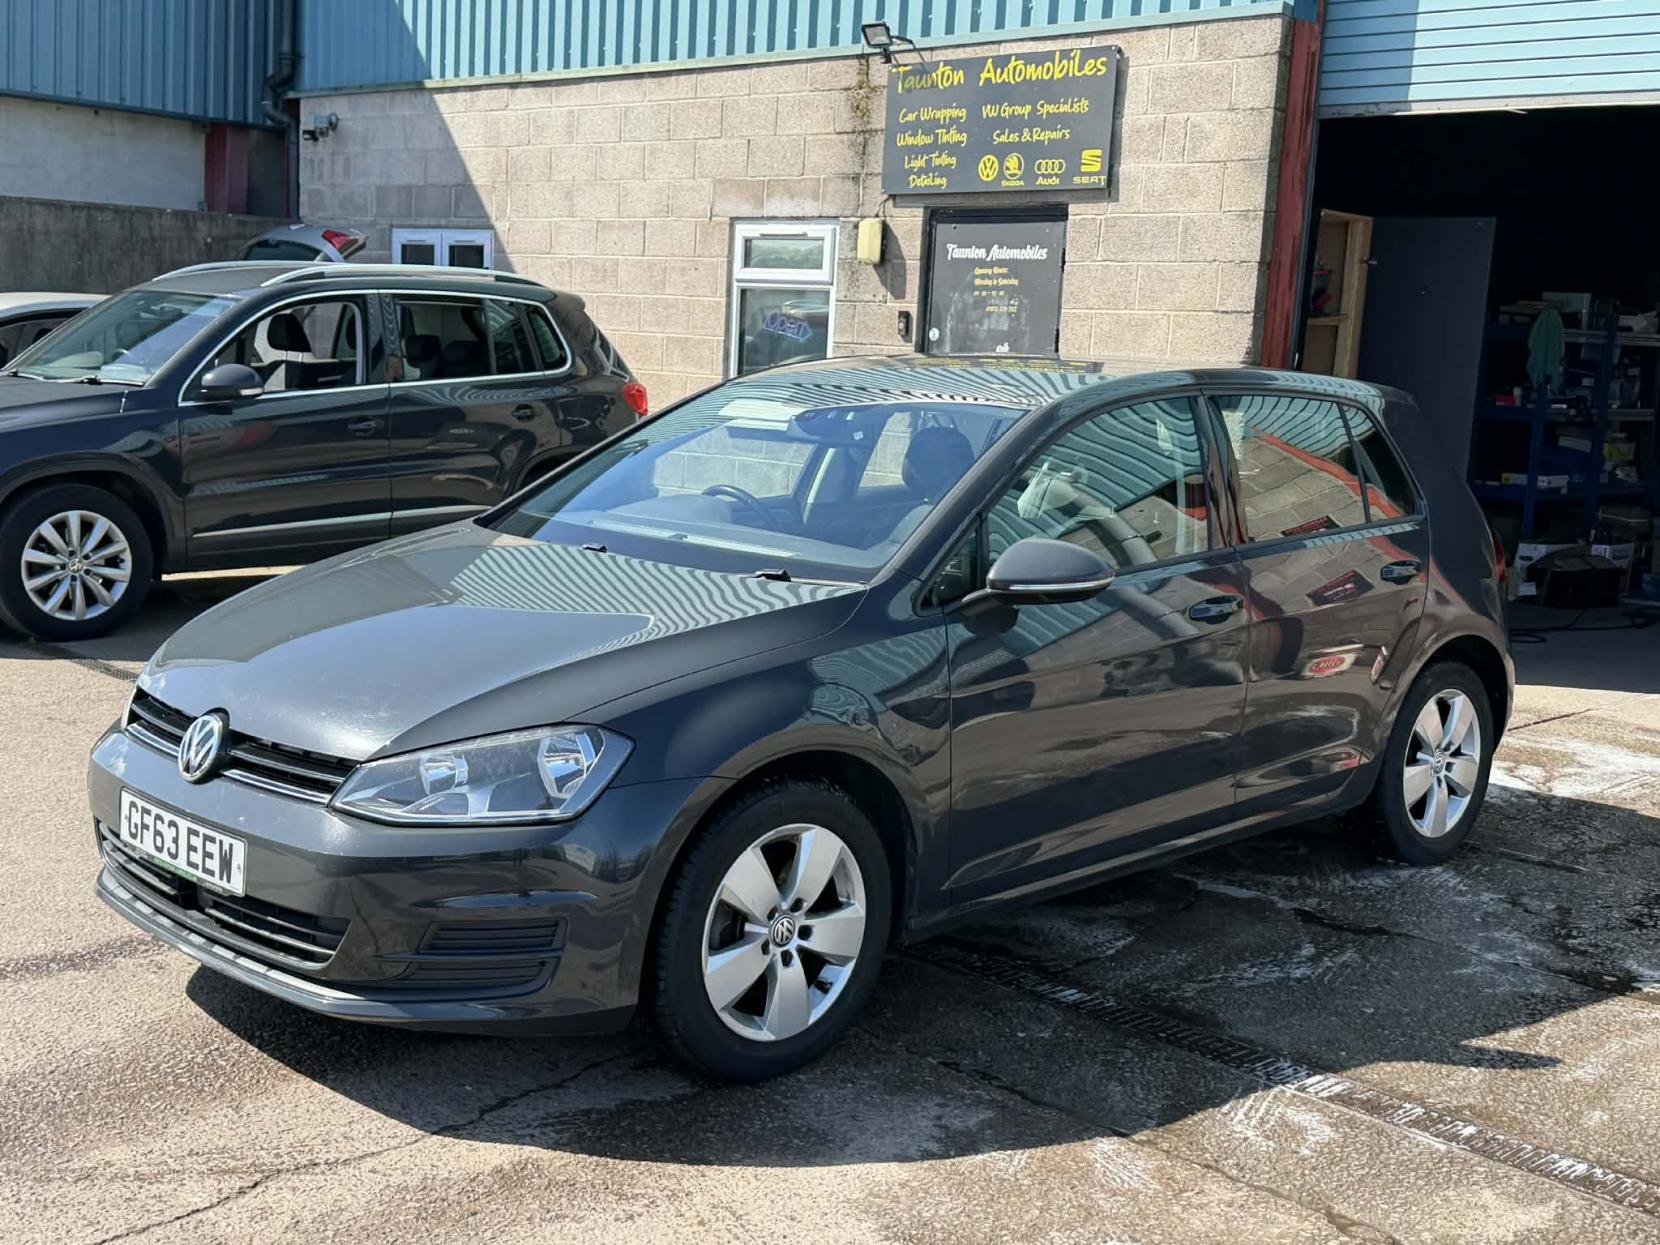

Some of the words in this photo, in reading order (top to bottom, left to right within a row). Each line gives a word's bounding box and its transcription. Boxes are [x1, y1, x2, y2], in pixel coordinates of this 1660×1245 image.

[897, 61, 965, 94] Taunton
[979, 50, 1107, 87] Automobiles
[899, 108, 918, 123] Car
[920, 102, 966, 125] Wrapping
[982, 104, 999, 119] VW
[1001, 102, 1032, 120] Group
[1037, 97, 1089, 119] Specialists
[897, 128, 934, 147] Window
[935, 124, 967, 147] Tinting
[993, 128, 1020, 145] Sales
[1021, 128, 1032, 142] &
[1033, 124, 1071, 146] Repairs
[905, 153, 929, 172] Light
[929, 150, 957, 169] Tinting
[909, 172, 948, 190] Detailing
[1036, 176, 1060, 186] Audi
[1072, 175, 1106, 186] SEAT
[946, 244, 987, 261] Taunton
[986, 244, 1048, 262] Automobiles
[127, 800, 180, 861] GF63
[186, 827, 234, 885] EEW
